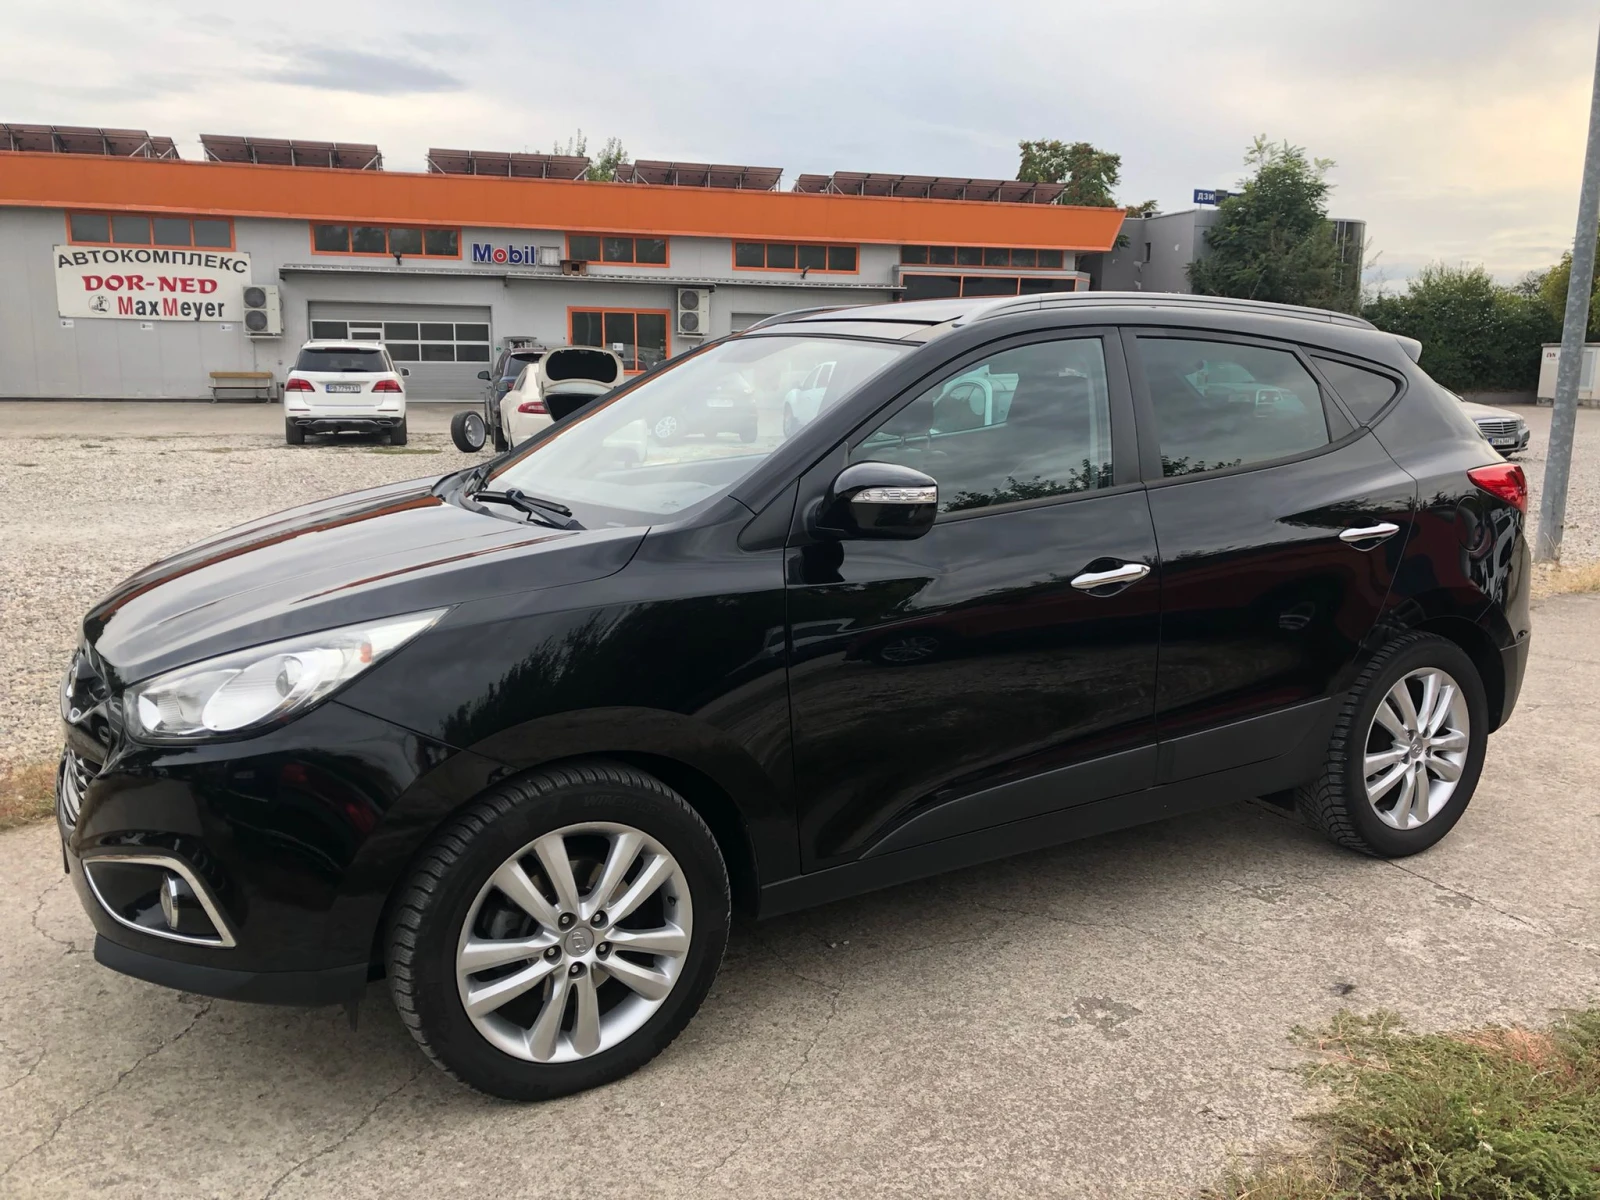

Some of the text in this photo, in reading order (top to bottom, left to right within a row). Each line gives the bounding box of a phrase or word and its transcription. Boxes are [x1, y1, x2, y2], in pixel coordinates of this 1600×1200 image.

[57, 249, 248, 274] АВТОКОМПЛЕКС
[472, 243, 536, 265] Mobil
[81, 274, 218, 294] DOR-NED
